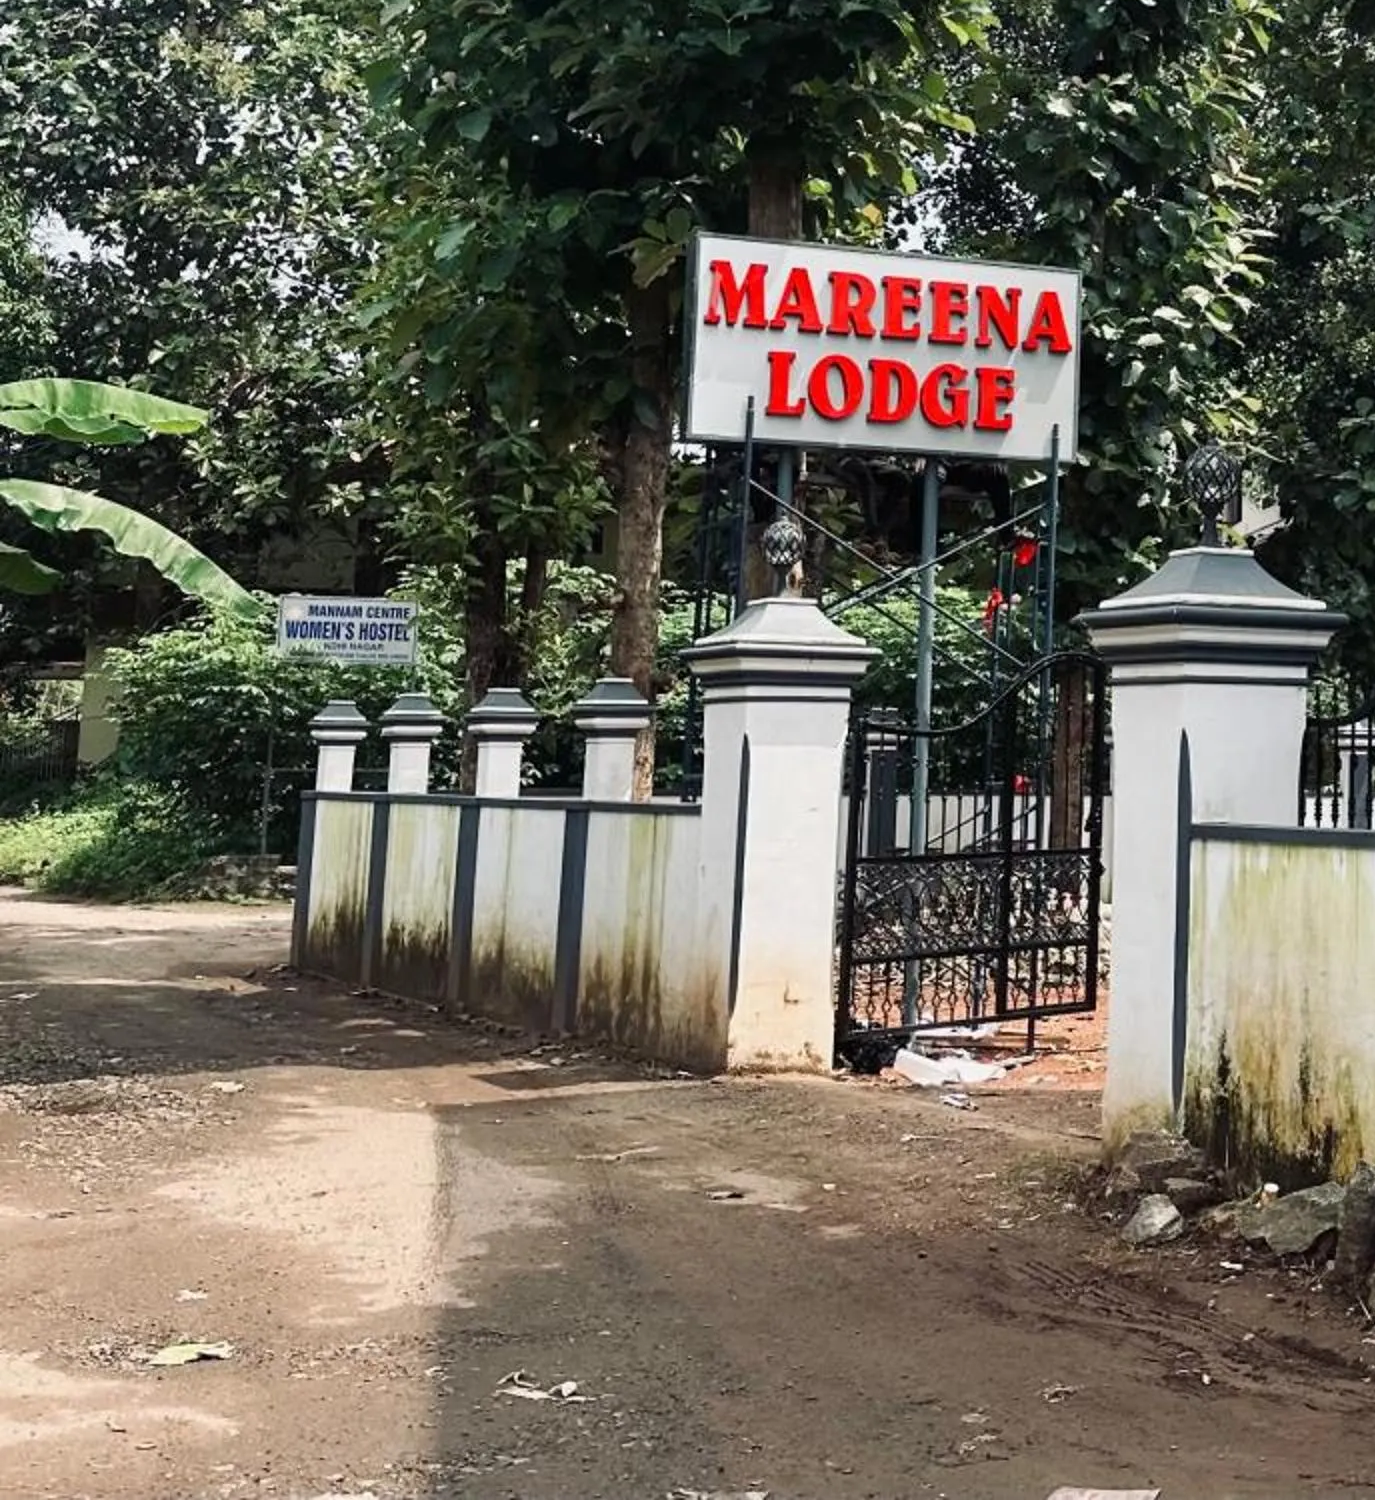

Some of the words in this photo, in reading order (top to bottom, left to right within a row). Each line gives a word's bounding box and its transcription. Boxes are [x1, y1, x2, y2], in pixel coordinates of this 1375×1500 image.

[703, 260, 1073, 354] MAREENA
[765, 350, 1018, 432] LODGE
[285, 620, 355, 640] WOMEN'S
[358, 623, 411, 642] HOSTEL
[307, 604, 363, 618] MANNAM
[365, 606, 411, 619] CENTRE
